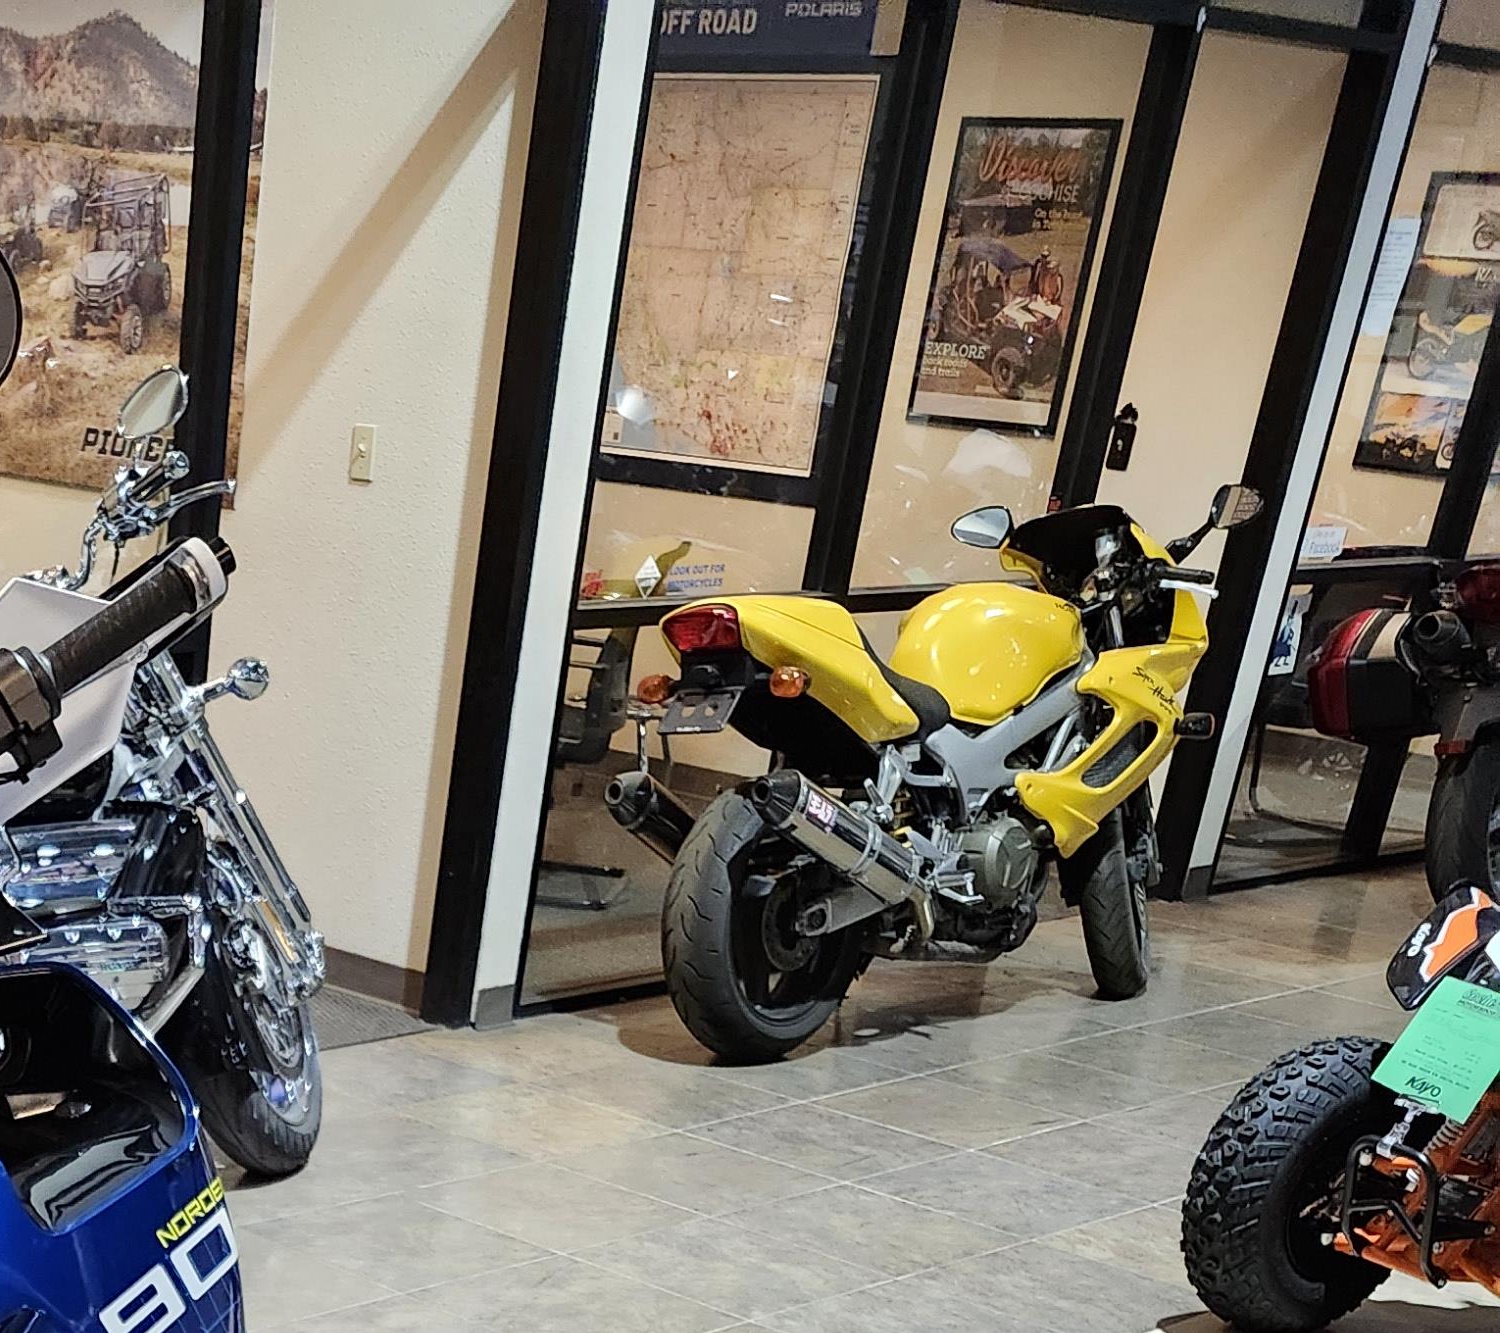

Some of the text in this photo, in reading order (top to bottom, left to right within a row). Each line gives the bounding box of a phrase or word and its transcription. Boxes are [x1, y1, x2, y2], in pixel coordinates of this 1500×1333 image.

[784, 1, 864, 18] POLARIS
[697, 8, 758, 35] ROAD
[925, 342, 987, 360] EXPLORE
[692, 564, 708, 575] OUT
[710, 563, 726, 574] FOR
[155, 1176, 225, 1249] NORDE
